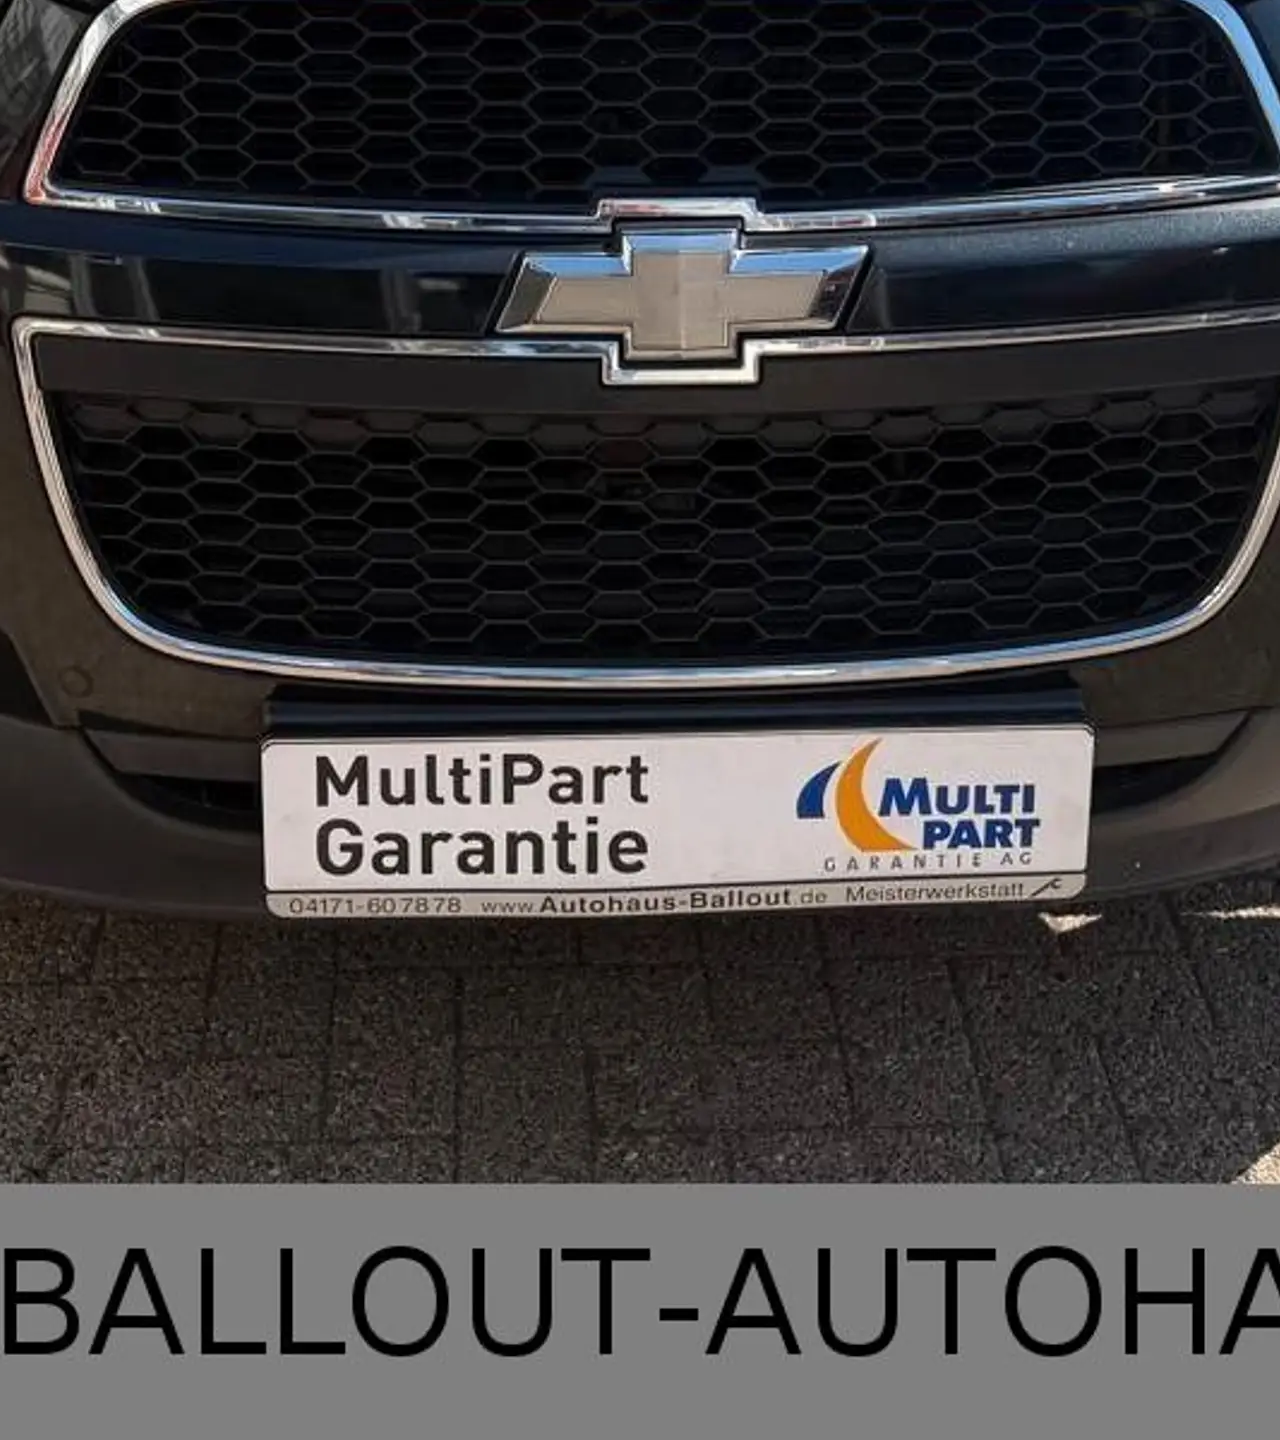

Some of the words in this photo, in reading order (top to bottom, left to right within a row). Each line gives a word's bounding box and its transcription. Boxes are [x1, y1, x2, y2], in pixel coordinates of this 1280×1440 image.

[315, 753, 650, 808] MultiPart
[878, 777, 1036, 816] MULTI
[315, 817, 650, 876] Garantie
[922, 818, 1041, 850] PART
[824, 853, 982, 873] GARANTIE
[999, 851, 1032, 866] AG
[288, 896, 462, 915] 04171-607878
[844, 882, 1024, 904] Meisterwerkstatt
